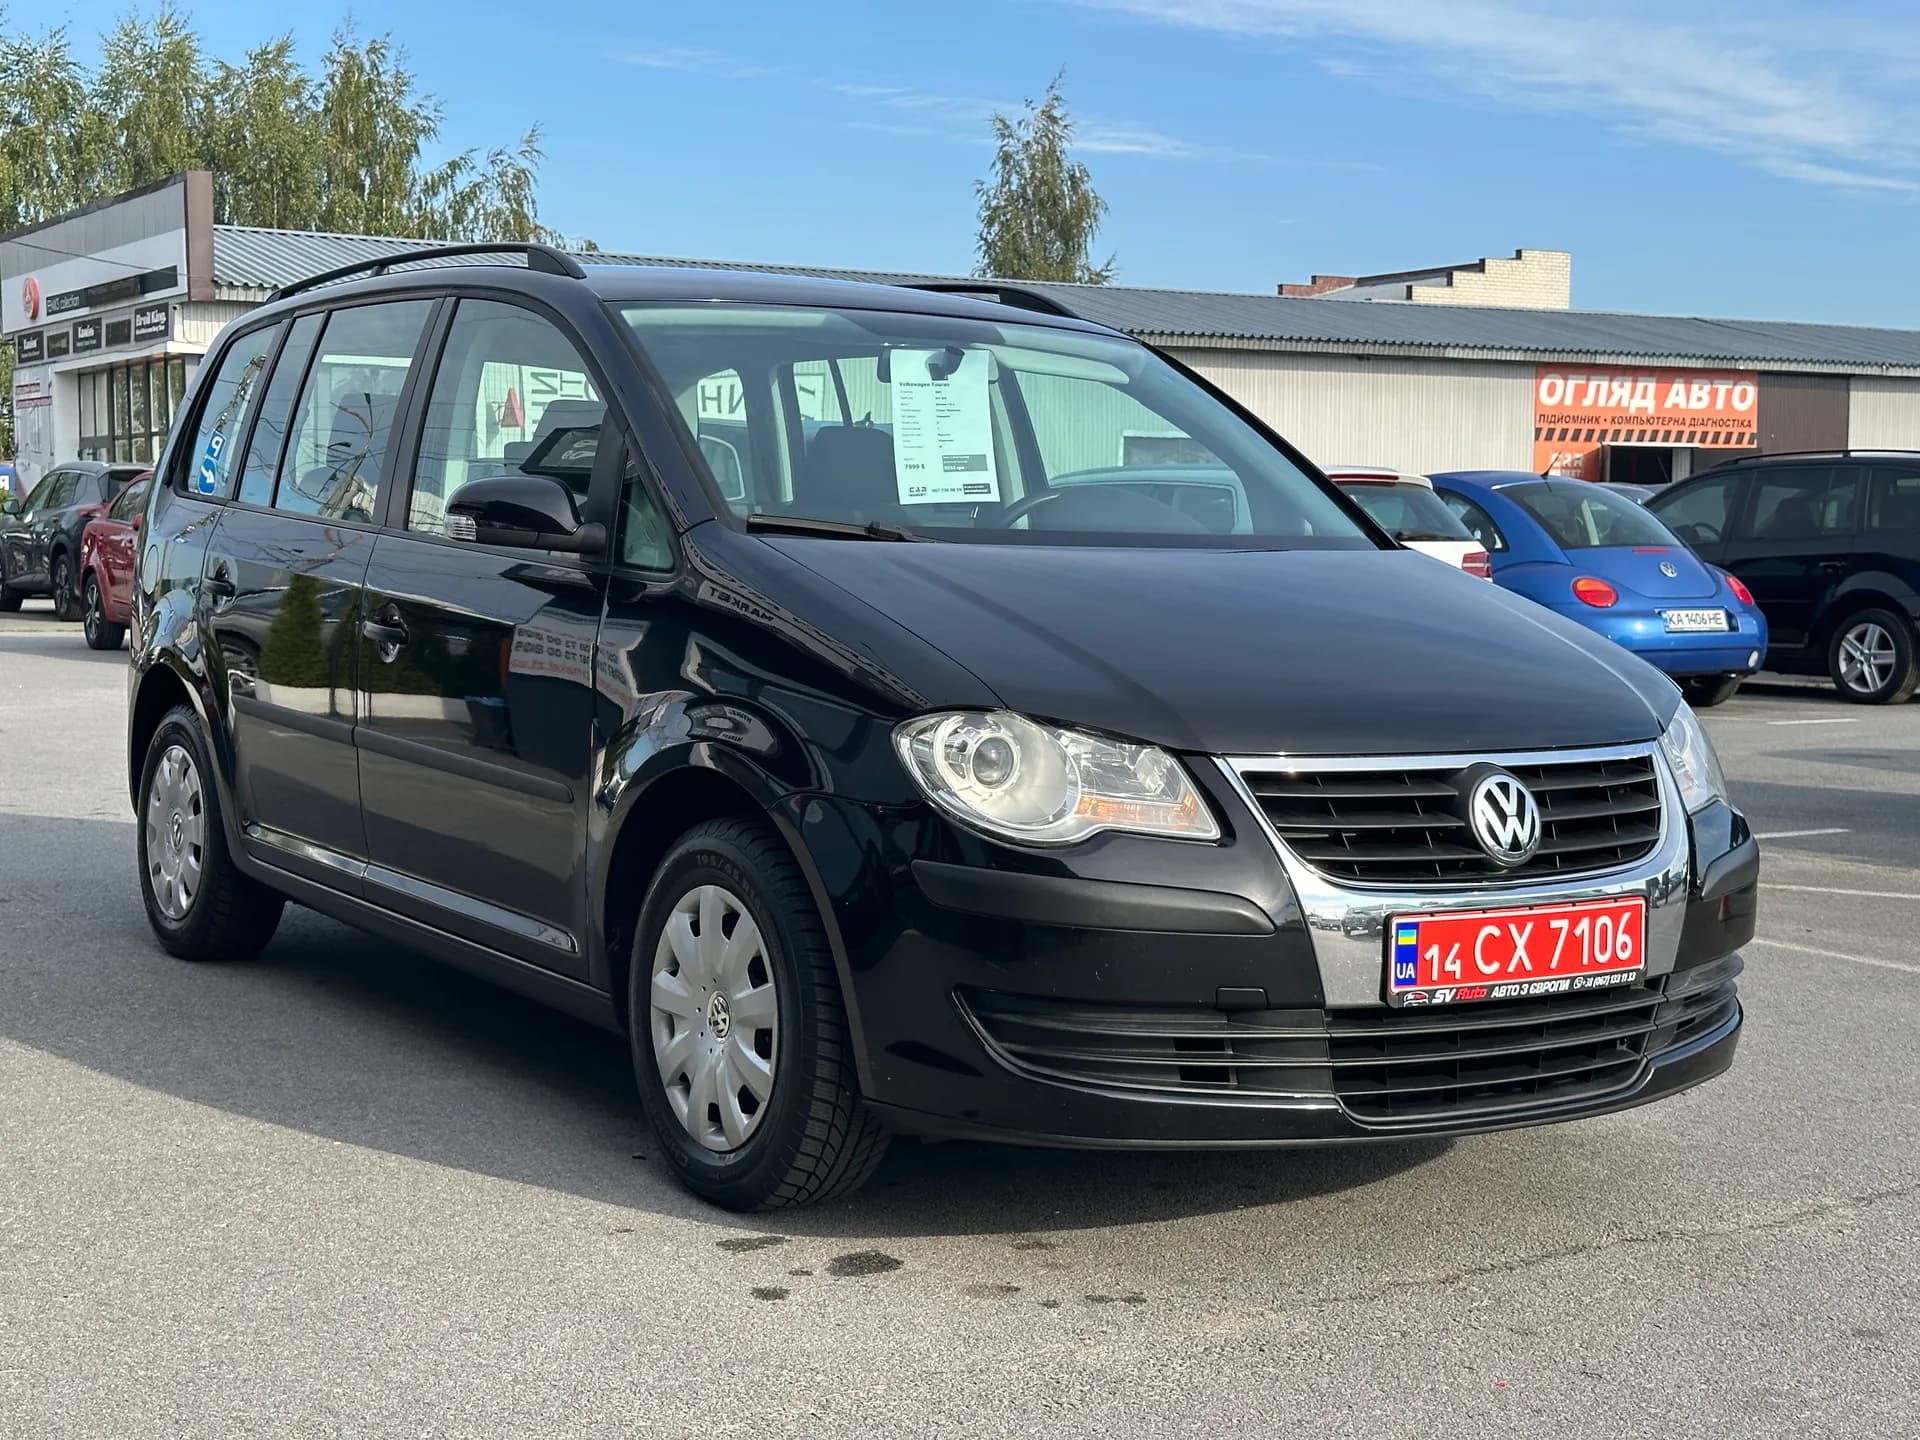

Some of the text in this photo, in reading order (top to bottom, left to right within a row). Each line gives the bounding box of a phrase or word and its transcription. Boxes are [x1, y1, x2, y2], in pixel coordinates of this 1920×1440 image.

[1539, 374, 1755, 414] ОГЛЯД АВТО
[1538, 413, 1601, 425] ПІДЙОМНИК
[1610, 415, 1686, 426] КОМПЬЮТЕРНА
[1423, 911, 1633, 981] 14 CX 7106
[1396, 962, 1416, 979] UA
[1456, 987, 1488, 1000] Auto
[1490, 985, 1520, 998] АВТО
[1529, 979, 1570, 994] ЄВРОПИ
